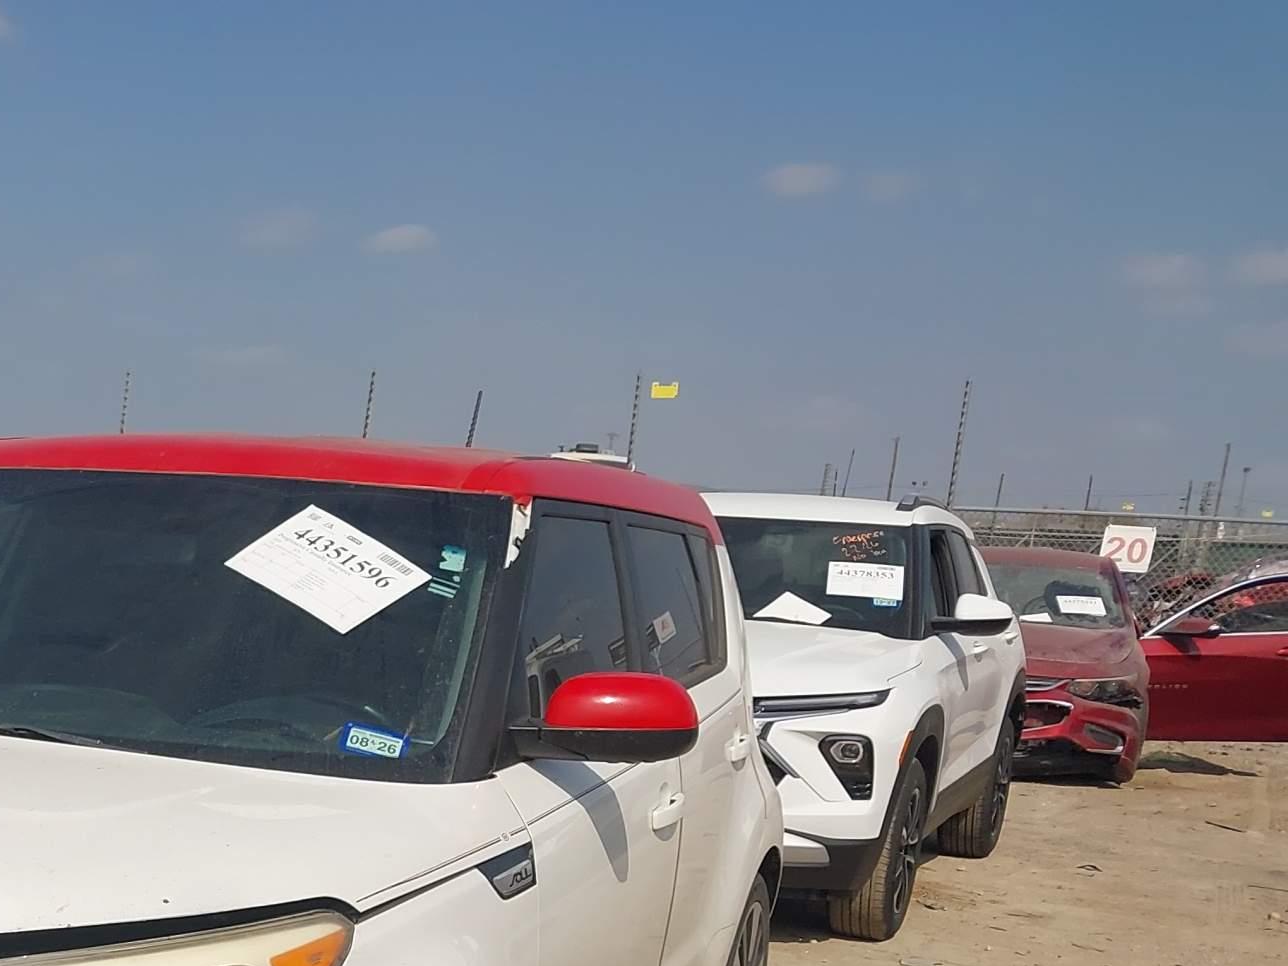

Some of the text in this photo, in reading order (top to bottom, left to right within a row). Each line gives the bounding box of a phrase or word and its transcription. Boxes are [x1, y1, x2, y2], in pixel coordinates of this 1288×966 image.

[293, 528, 397, 589] 44351596
[1103, 536, 1148, 564] 20
[349, 734, 398, 755] 08 26
